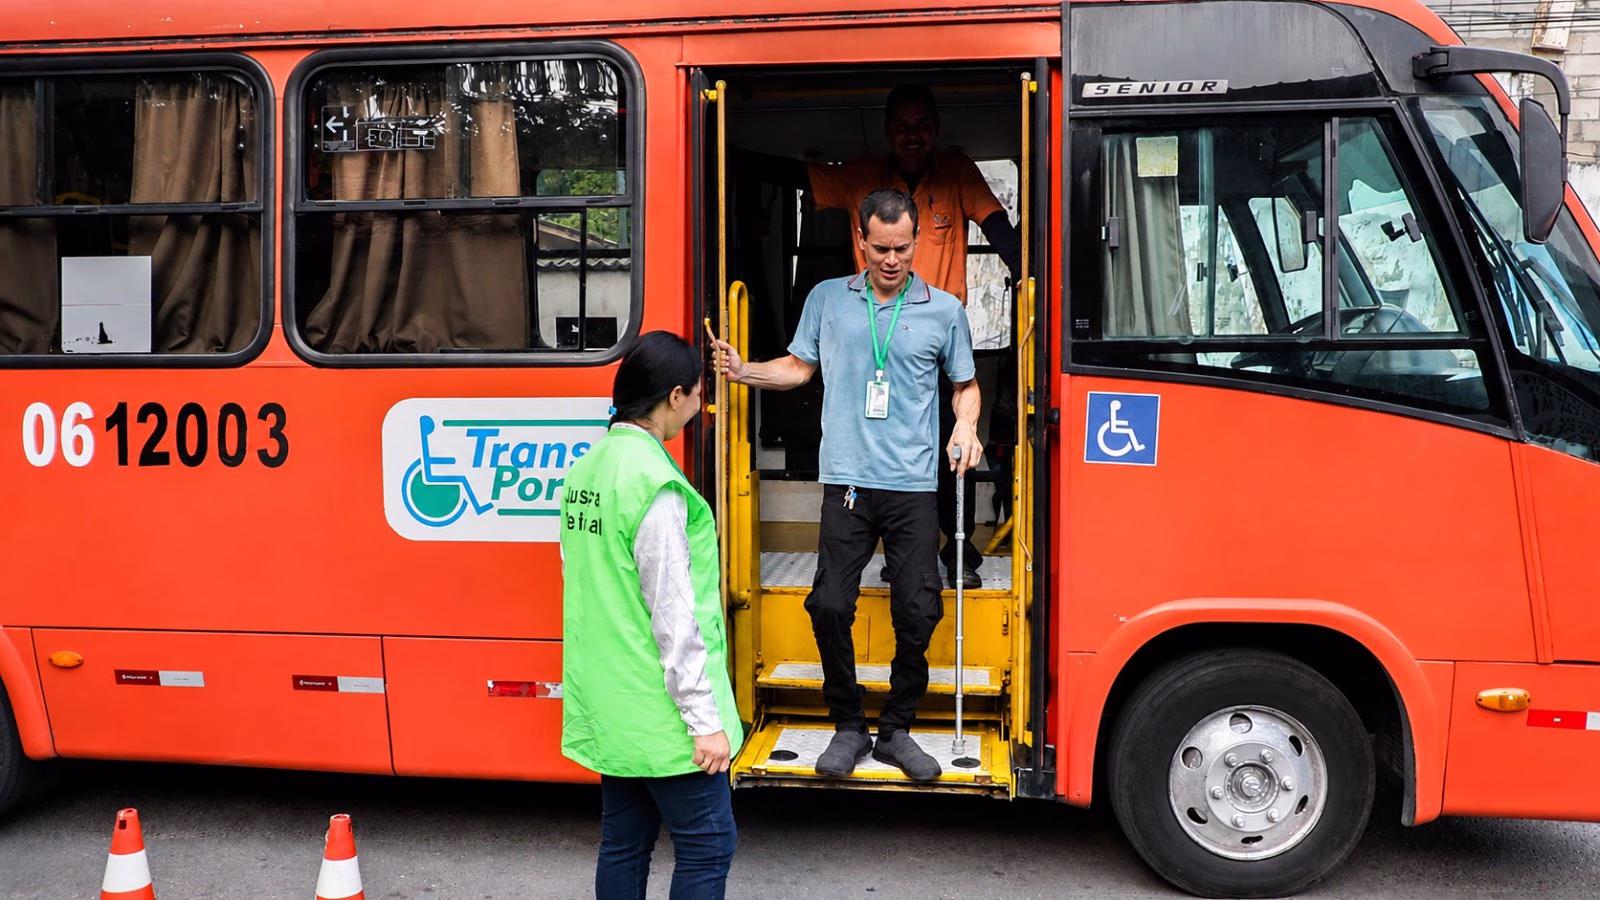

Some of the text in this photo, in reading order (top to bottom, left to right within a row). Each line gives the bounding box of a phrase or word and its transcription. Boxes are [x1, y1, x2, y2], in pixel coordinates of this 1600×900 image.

[1094, 81, 1218, 95] SENIOR
[22, 401, 289, 468] 06 12003
[491, 465, 565, 501] Por
